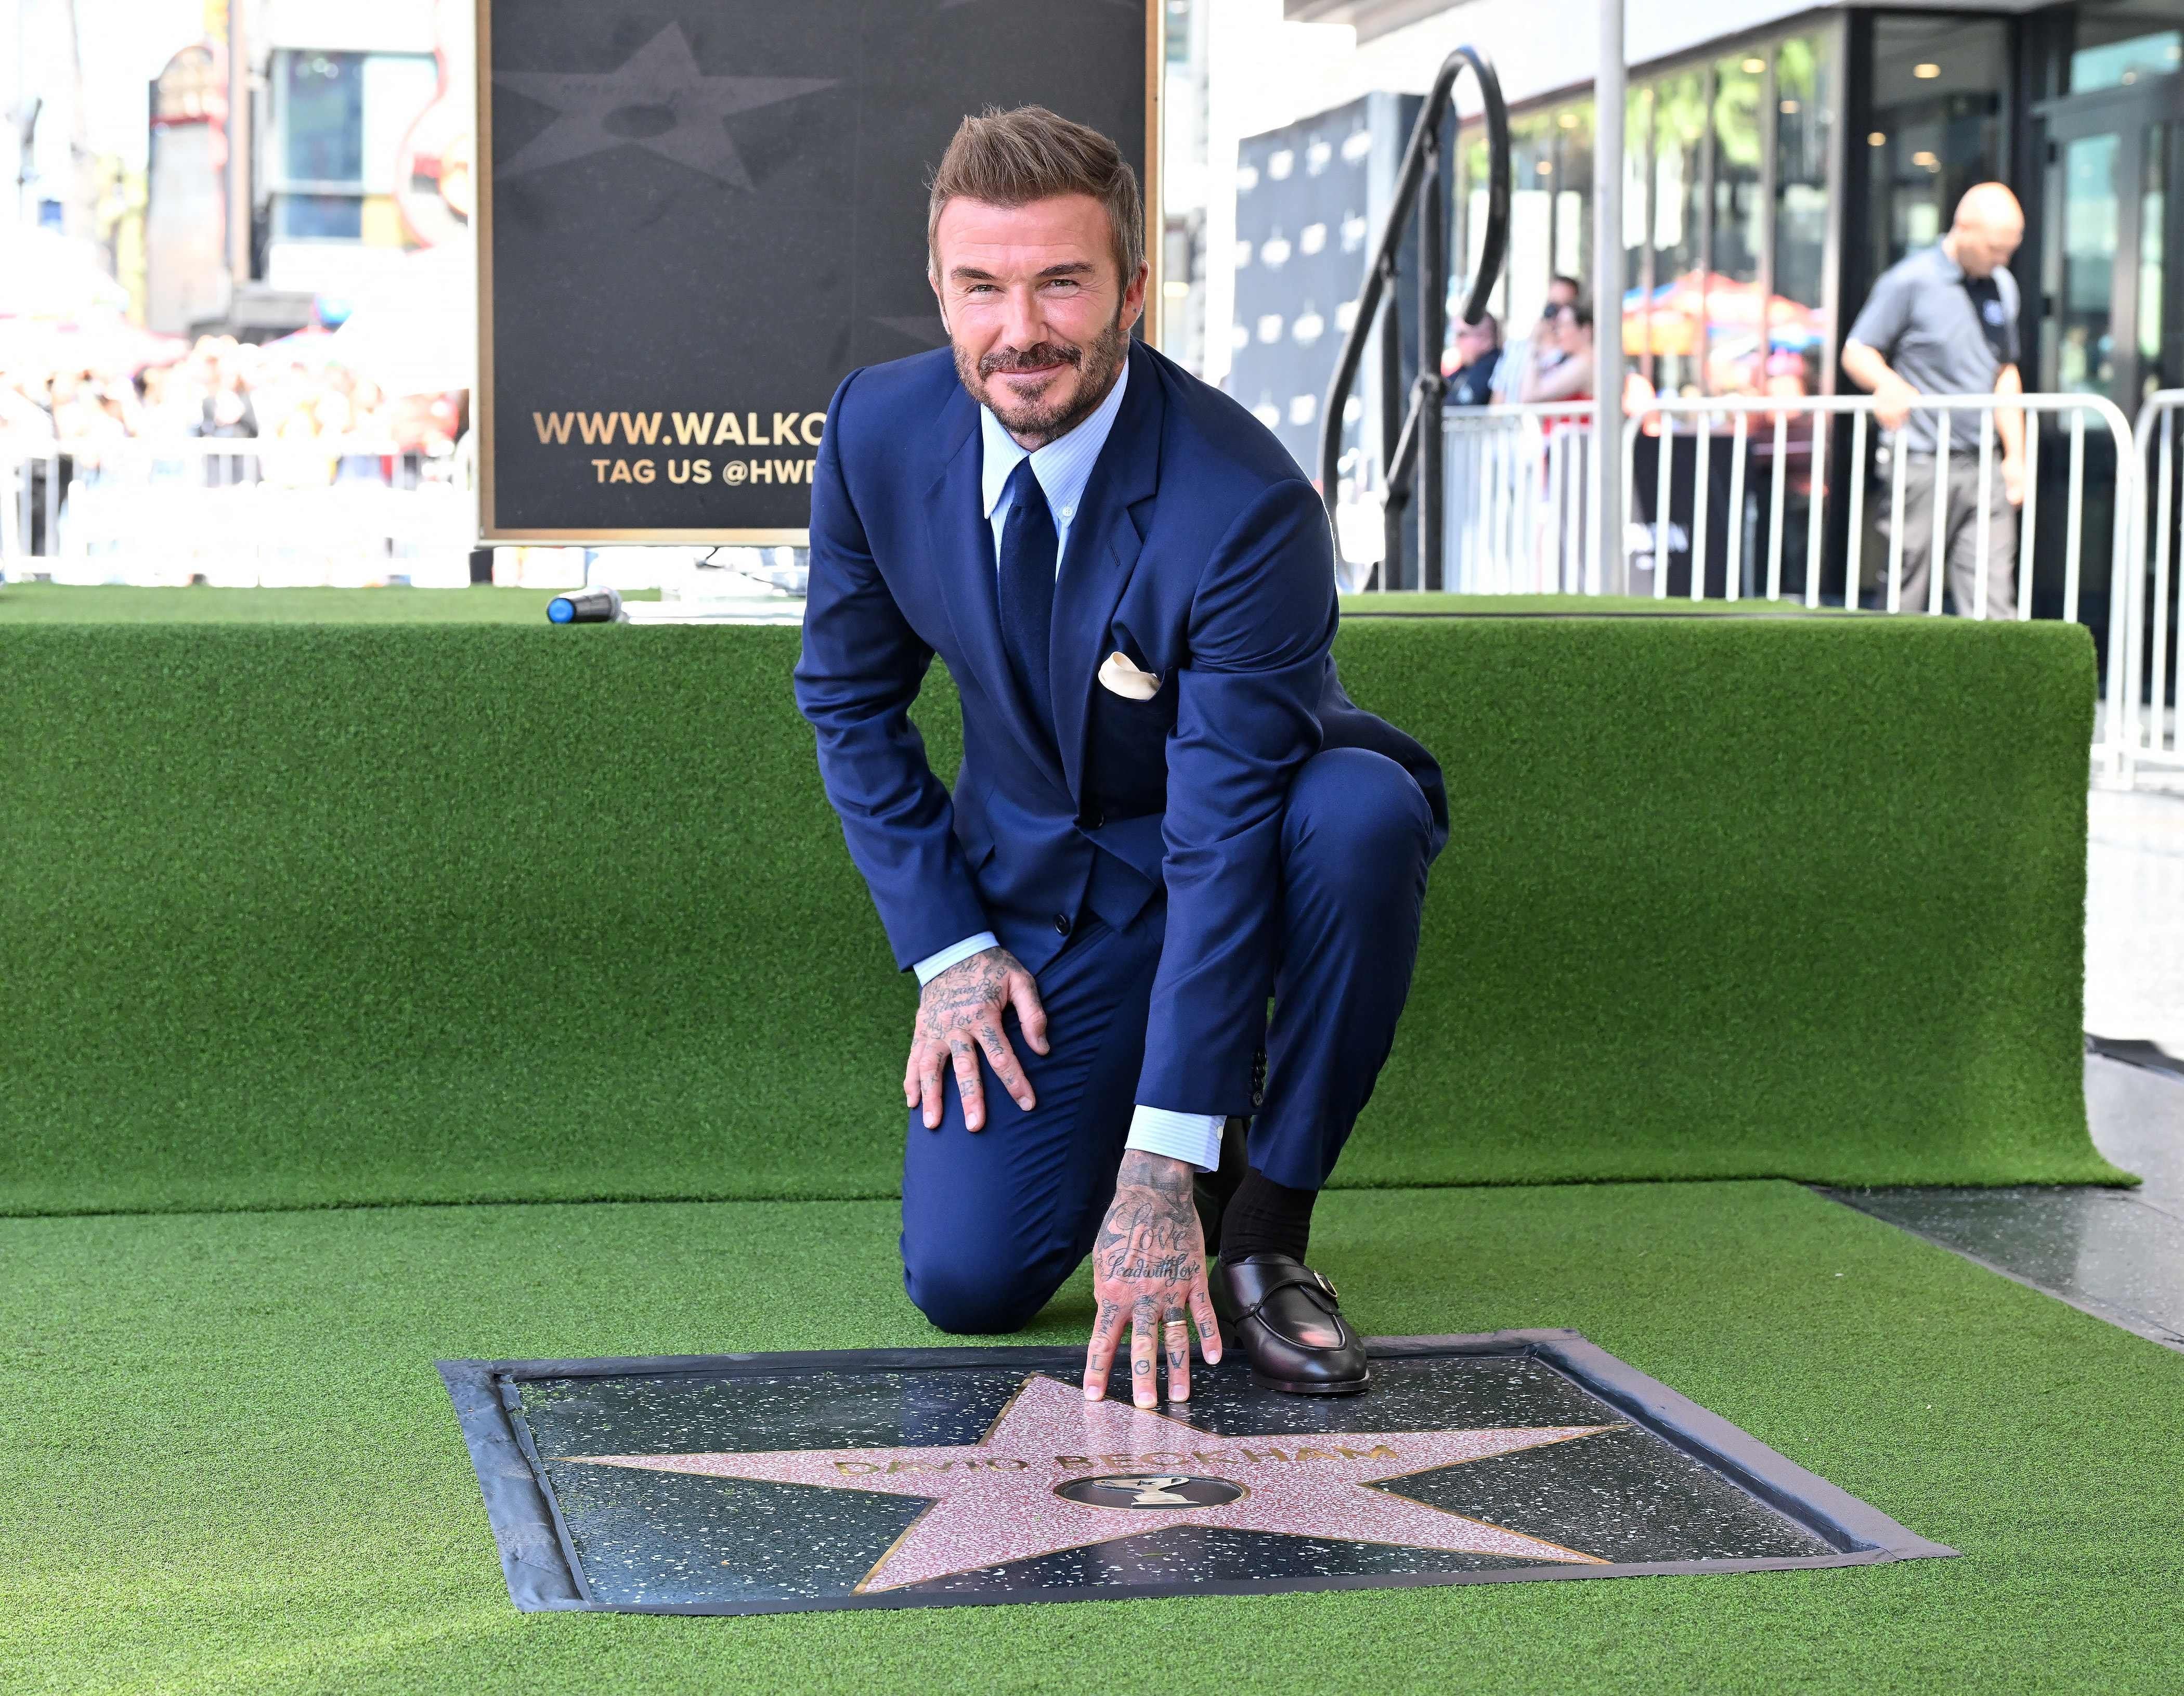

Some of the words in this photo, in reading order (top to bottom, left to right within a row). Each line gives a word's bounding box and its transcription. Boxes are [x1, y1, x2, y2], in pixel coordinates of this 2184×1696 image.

[592, 459, 657, 484] TAG
[667, 459, 712, 484] US
[835, 1457, 1030, 1476] DAVID
[1051, 1444, 1400, 1470] BECKHAM
